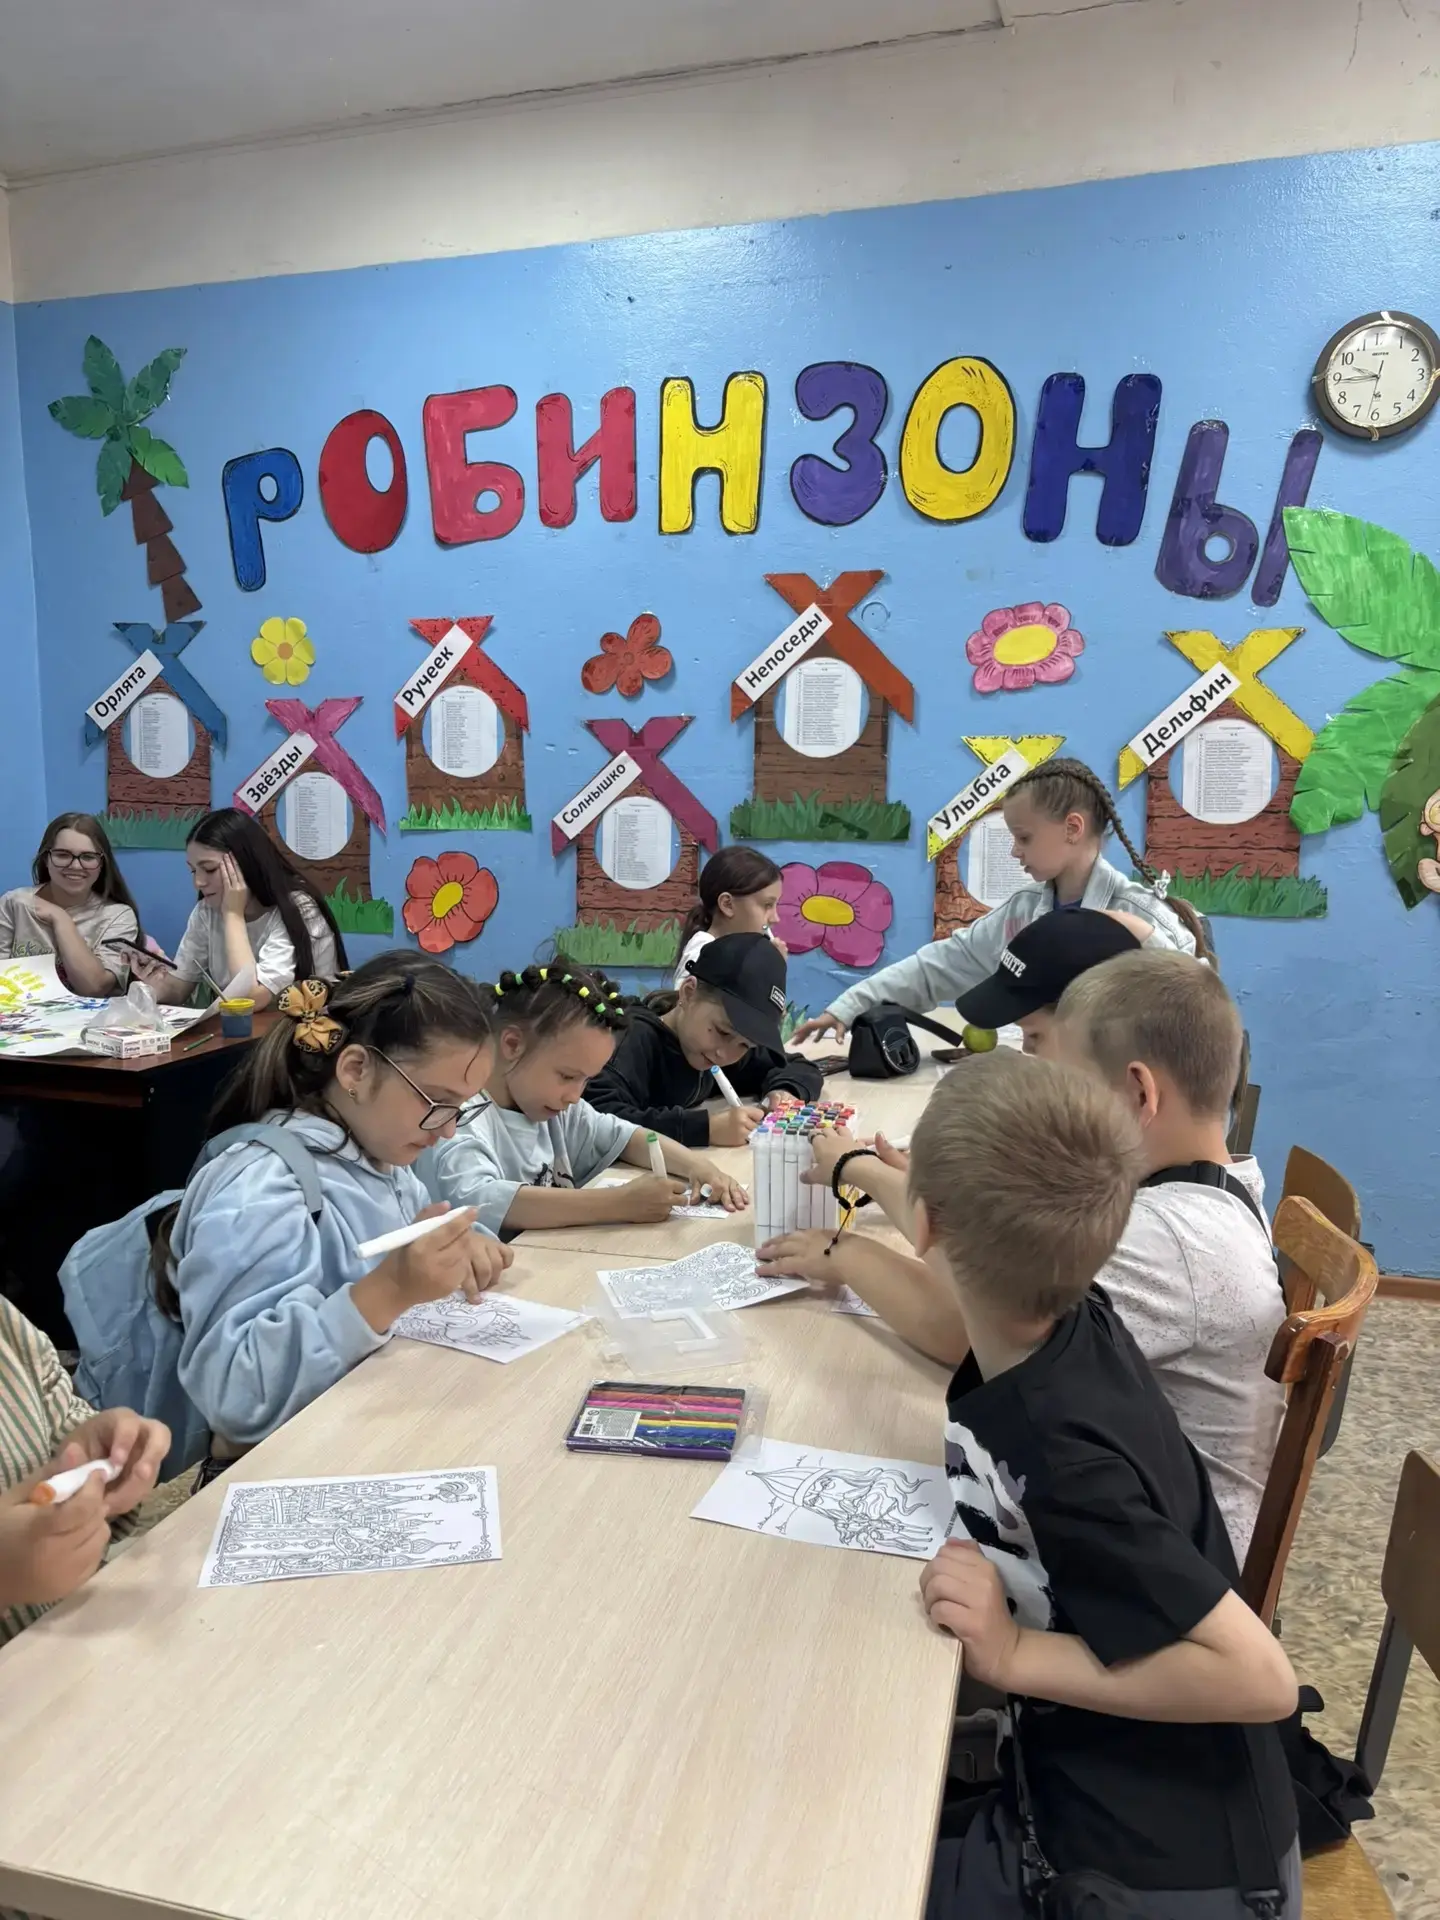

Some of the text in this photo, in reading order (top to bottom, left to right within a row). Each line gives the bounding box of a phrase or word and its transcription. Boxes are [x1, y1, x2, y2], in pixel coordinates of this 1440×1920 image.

[1341, 352, 1354, 366] 10
[1411, 348, 1420, 362] 2
[1333, 372, 1342, 386] 9
[1416, 367, 1425, 381] 3
[1337, 391, 1347, 404] 8
[1406, 388, 1415, 401] 4
[1352, 404, 1362, 418] 7
[1370, 407, 1380, 421] 6
[1393, 402, 1402, 416] 5
[222, 355, 1323, 606] РОБИНЗОНЫ
[744, 612, 823, 689] Непоседы
[401, 646, 454, 706] Ручеек
[94, 665, 147, 718] Орлята
[1141, 672, 1232, 758] Дельфин
[246, 745, 303, 803] Звёзды
[561, 763, 626, 825] Солнышко
[934, 763, 1012, 830] Улыбка
